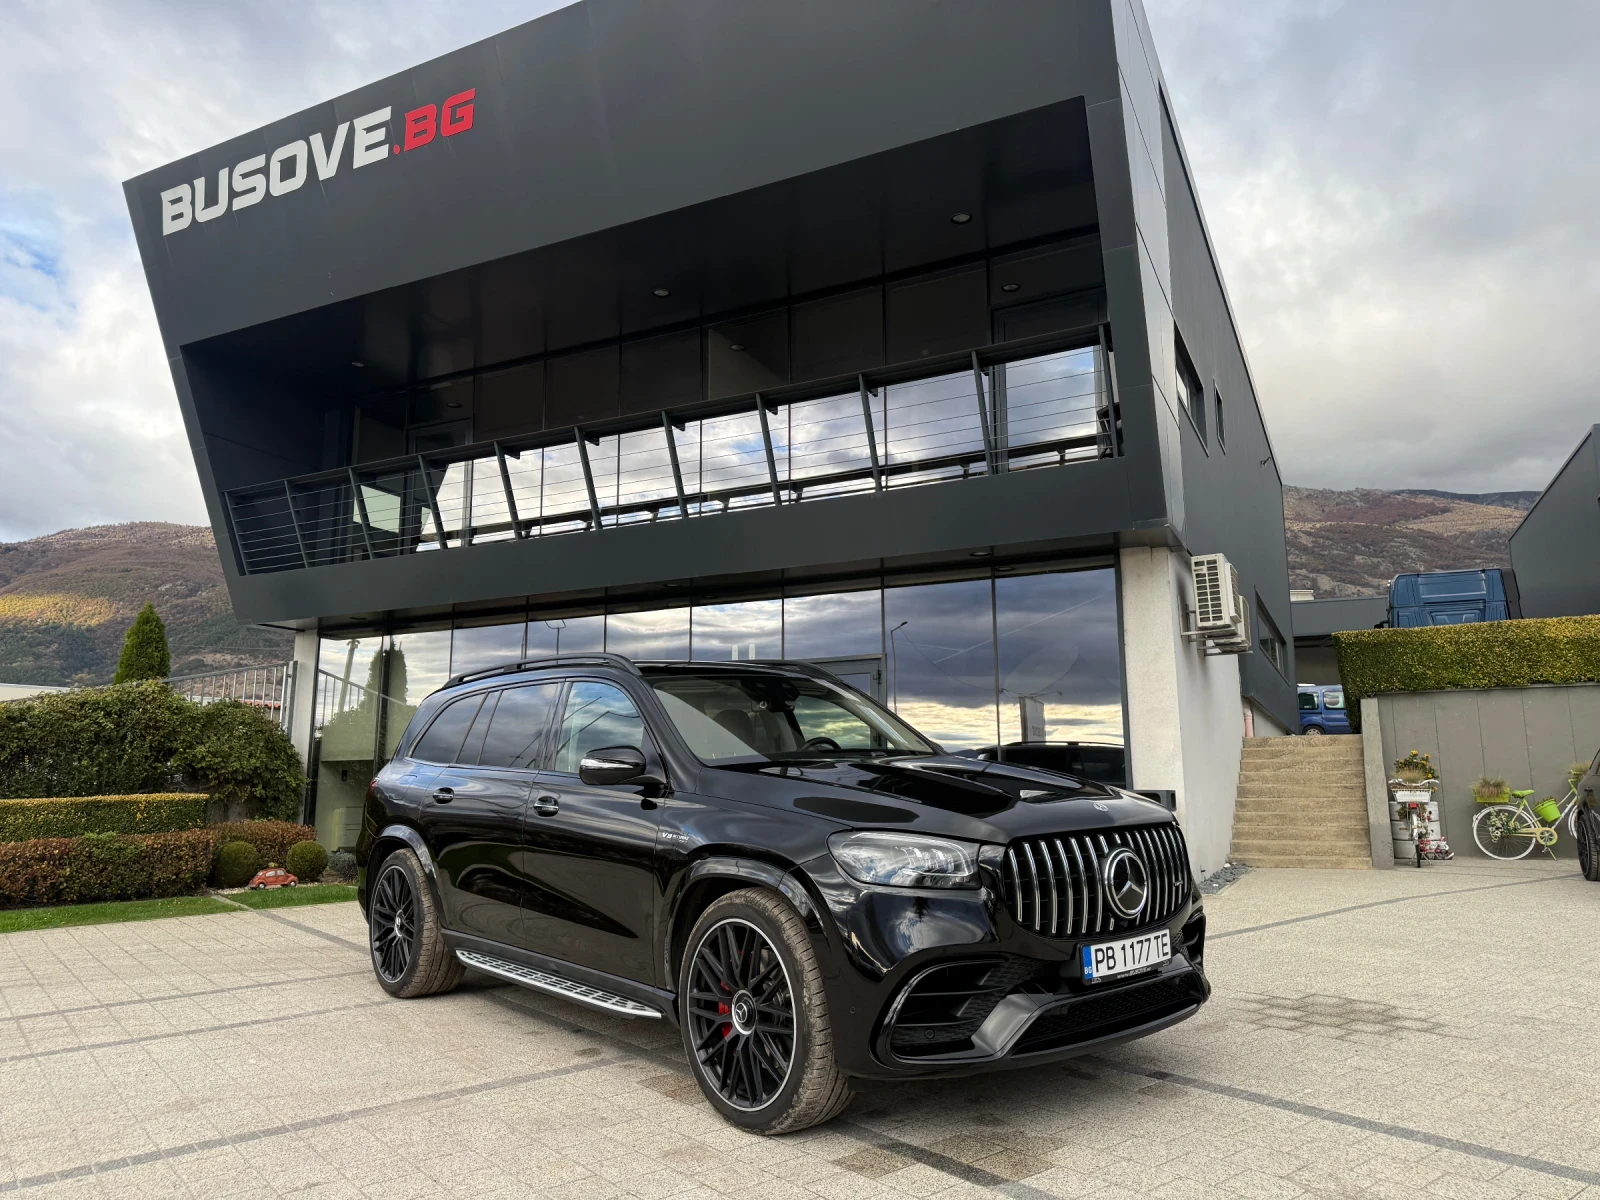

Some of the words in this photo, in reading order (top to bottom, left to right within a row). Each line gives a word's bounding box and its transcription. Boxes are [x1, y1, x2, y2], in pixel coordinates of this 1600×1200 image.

[161, 88, 476, 236] BUSOVE.BG
[1084, 965, 1093, 975] BG
[1094, 945, 1117, 973] PB
[1121, 938, 1152, 968] 1177
[1154, 932, 1169, 959] TE
